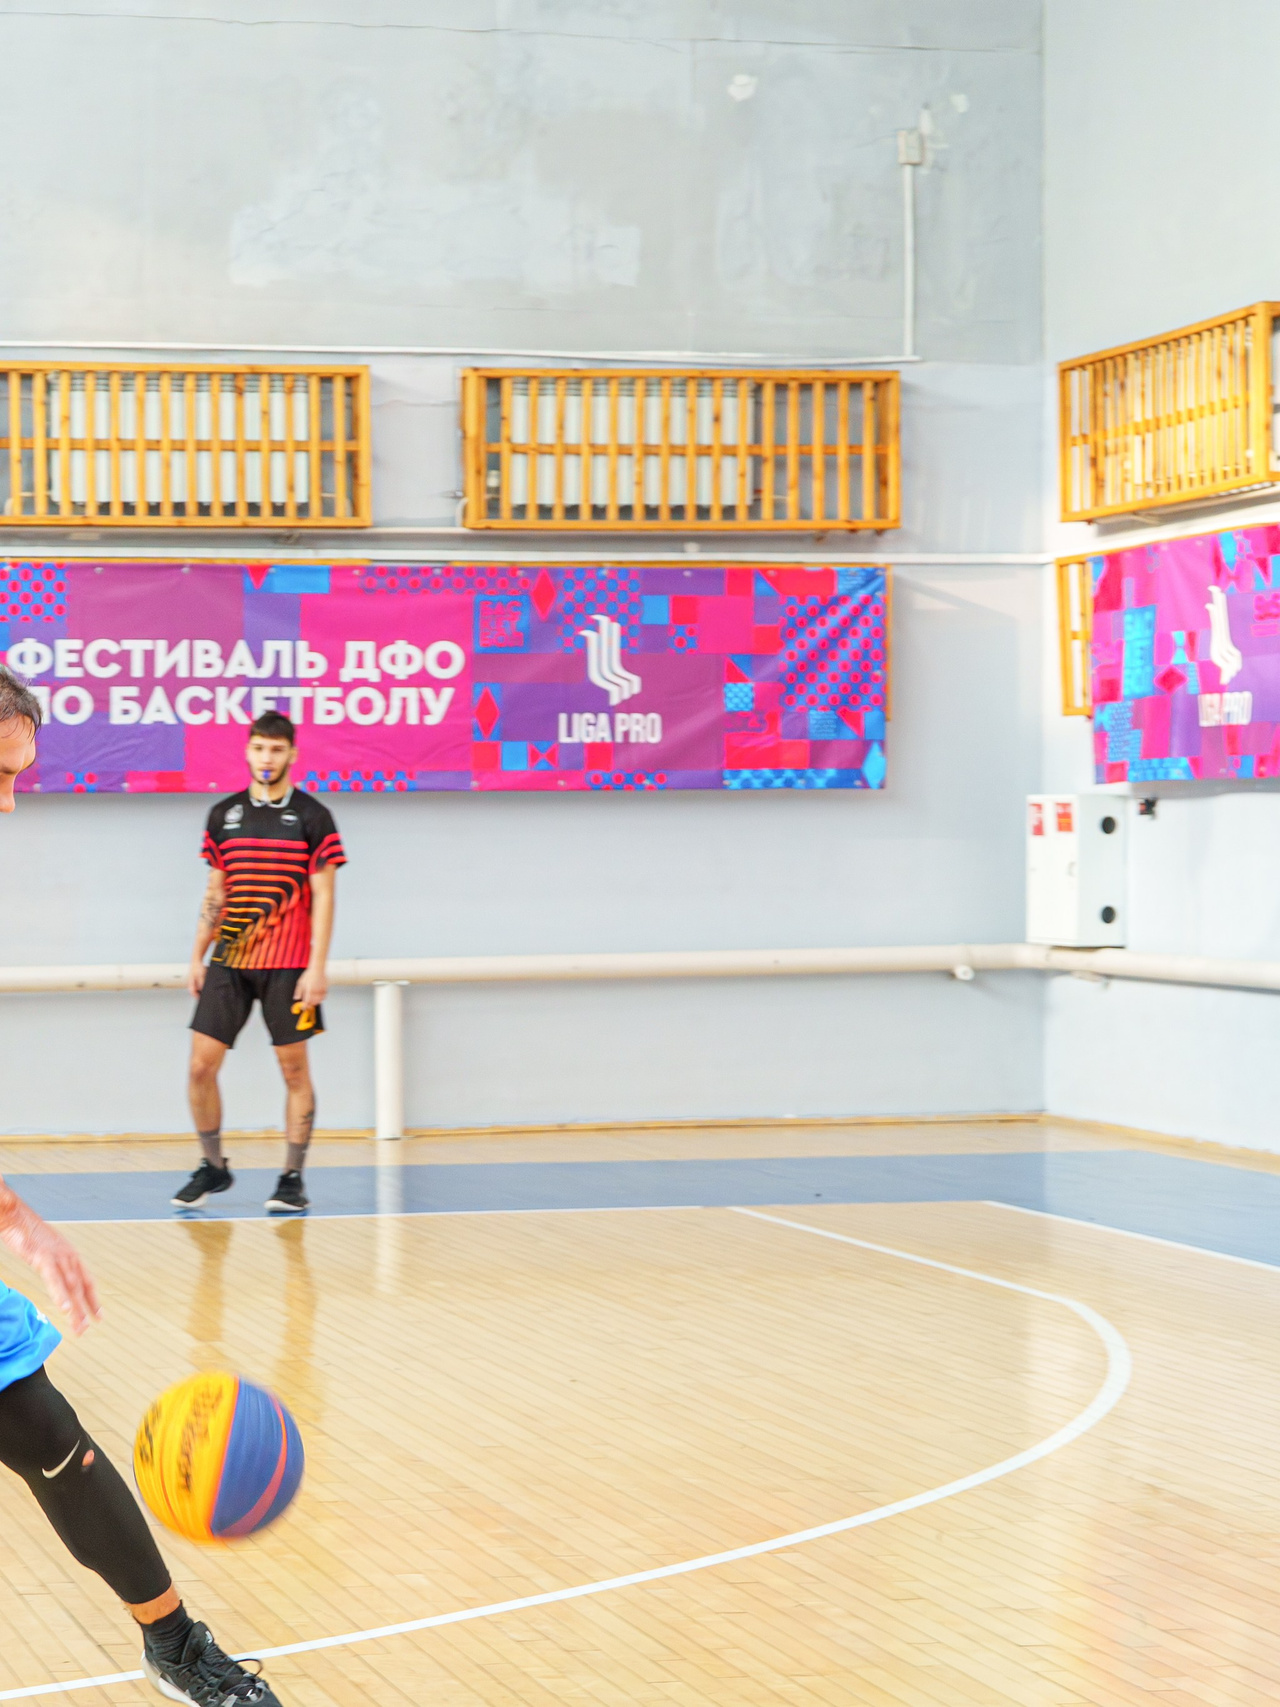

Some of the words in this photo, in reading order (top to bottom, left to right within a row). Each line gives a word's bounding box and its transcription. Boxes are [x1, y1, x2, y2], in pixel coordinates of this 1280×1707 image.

[6, 638, 328, 679] ФЕСТИВАЛЬ
[339, 640, 466, 683] ДФО
[108, 684, 456, 726] БАСКЕТБОЛУ
[558, 712, 612, 743] LIGA
[614, 712, 662, 743] PRO
